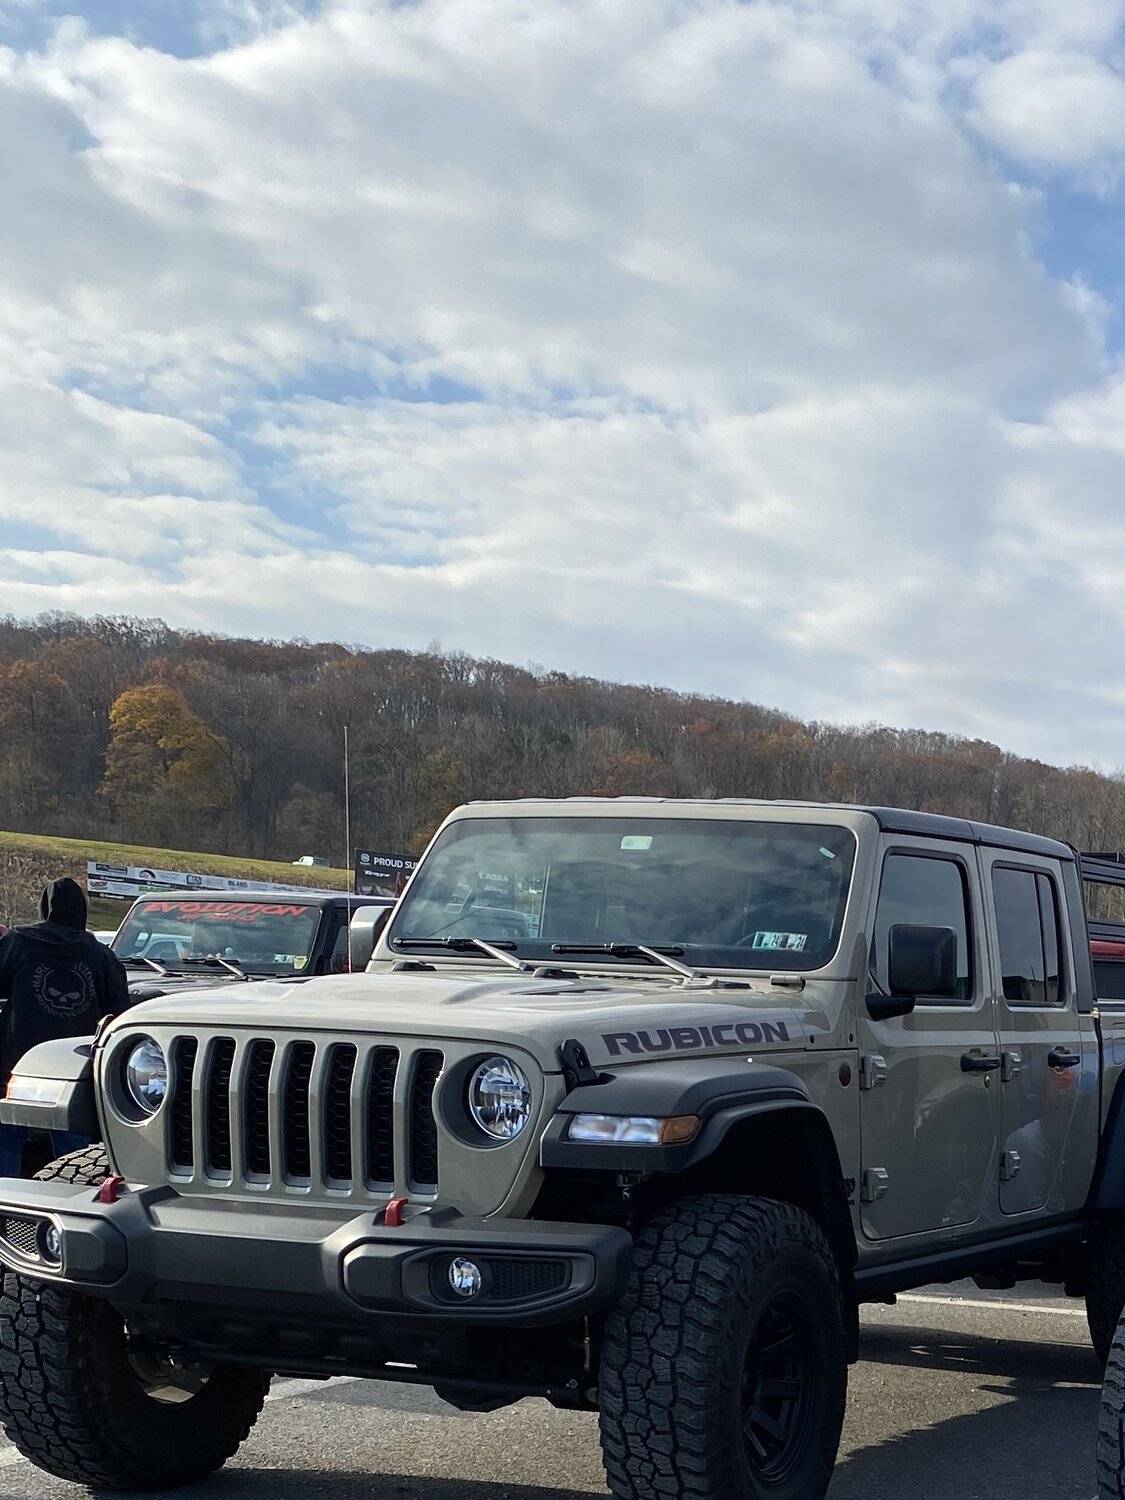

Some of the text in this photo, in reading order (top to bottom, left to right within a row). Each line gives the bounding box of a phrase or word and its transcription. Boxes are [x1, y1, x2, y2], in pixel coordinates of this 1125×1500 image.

[373, 857, 418, 870] PROUD SU
[143, 902, 308, 917] EVOLUTION
[601, 1021, 790, 1056] RUBICON
